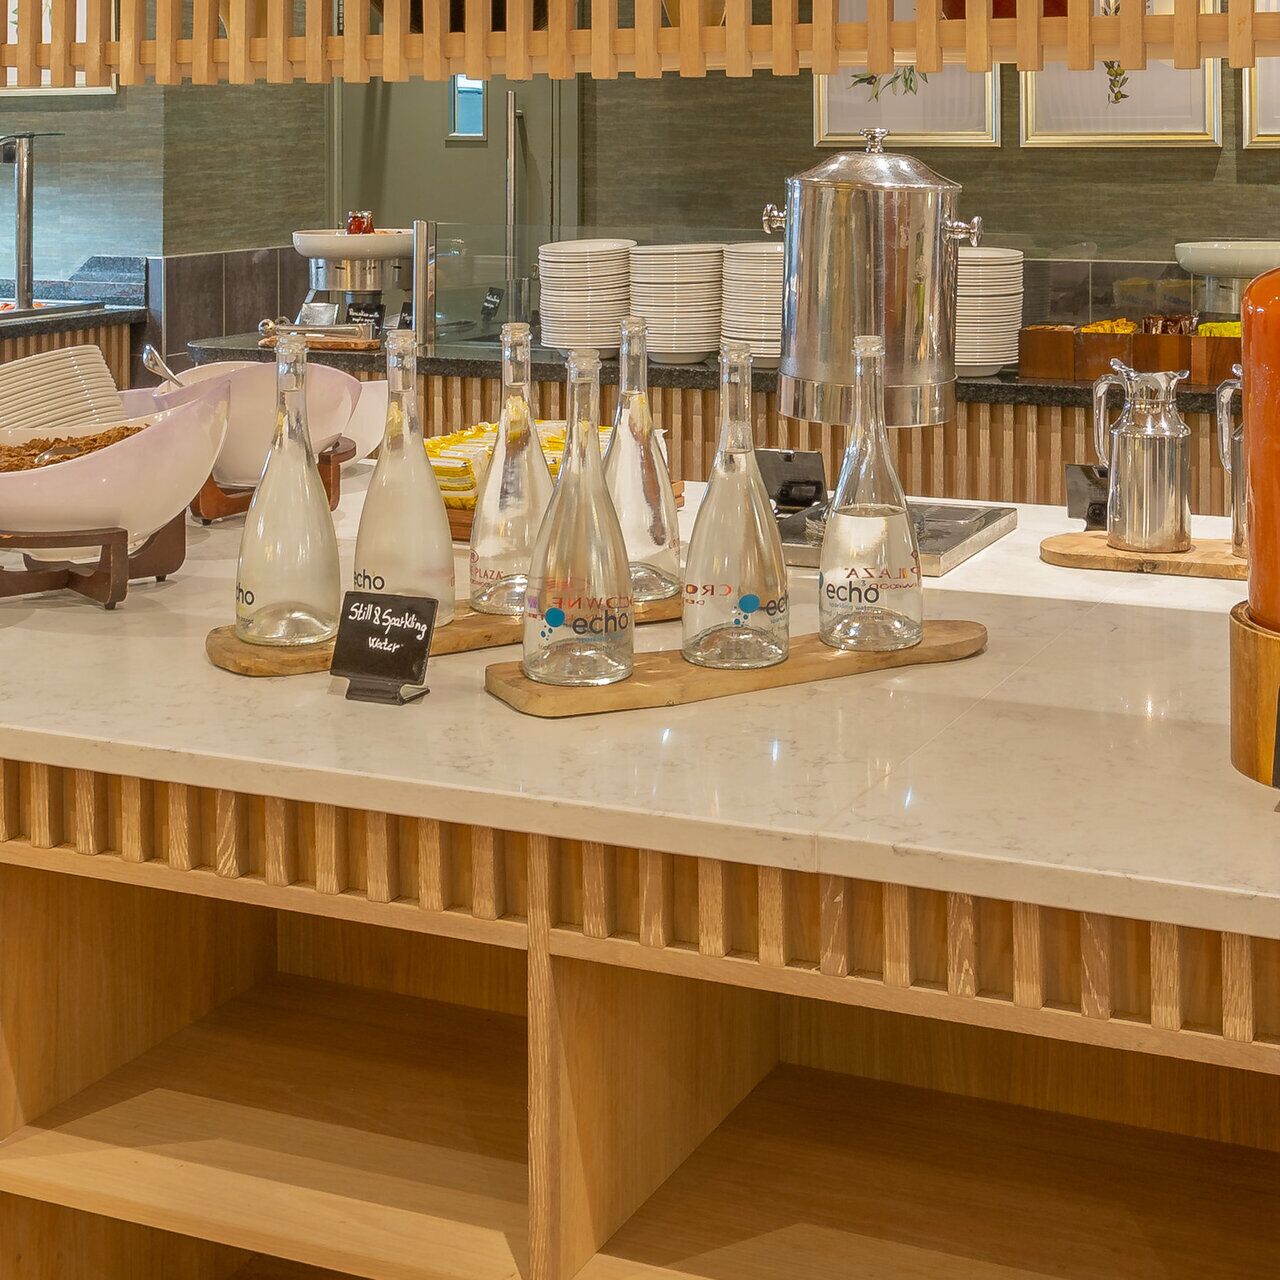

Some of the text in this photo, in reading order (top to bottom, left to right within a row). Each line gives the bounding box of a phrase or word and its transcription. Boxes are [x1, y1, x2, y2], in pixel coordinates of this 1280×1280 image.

[354, 568, 385, 590] cho
[826, 580, 880, 604] echo
[348, 603, 373, 621] Still
[382, 609, 427, 640] Sparkling
[572, 609, 629, 635] echo
[368, 636, 400, 653] Water
